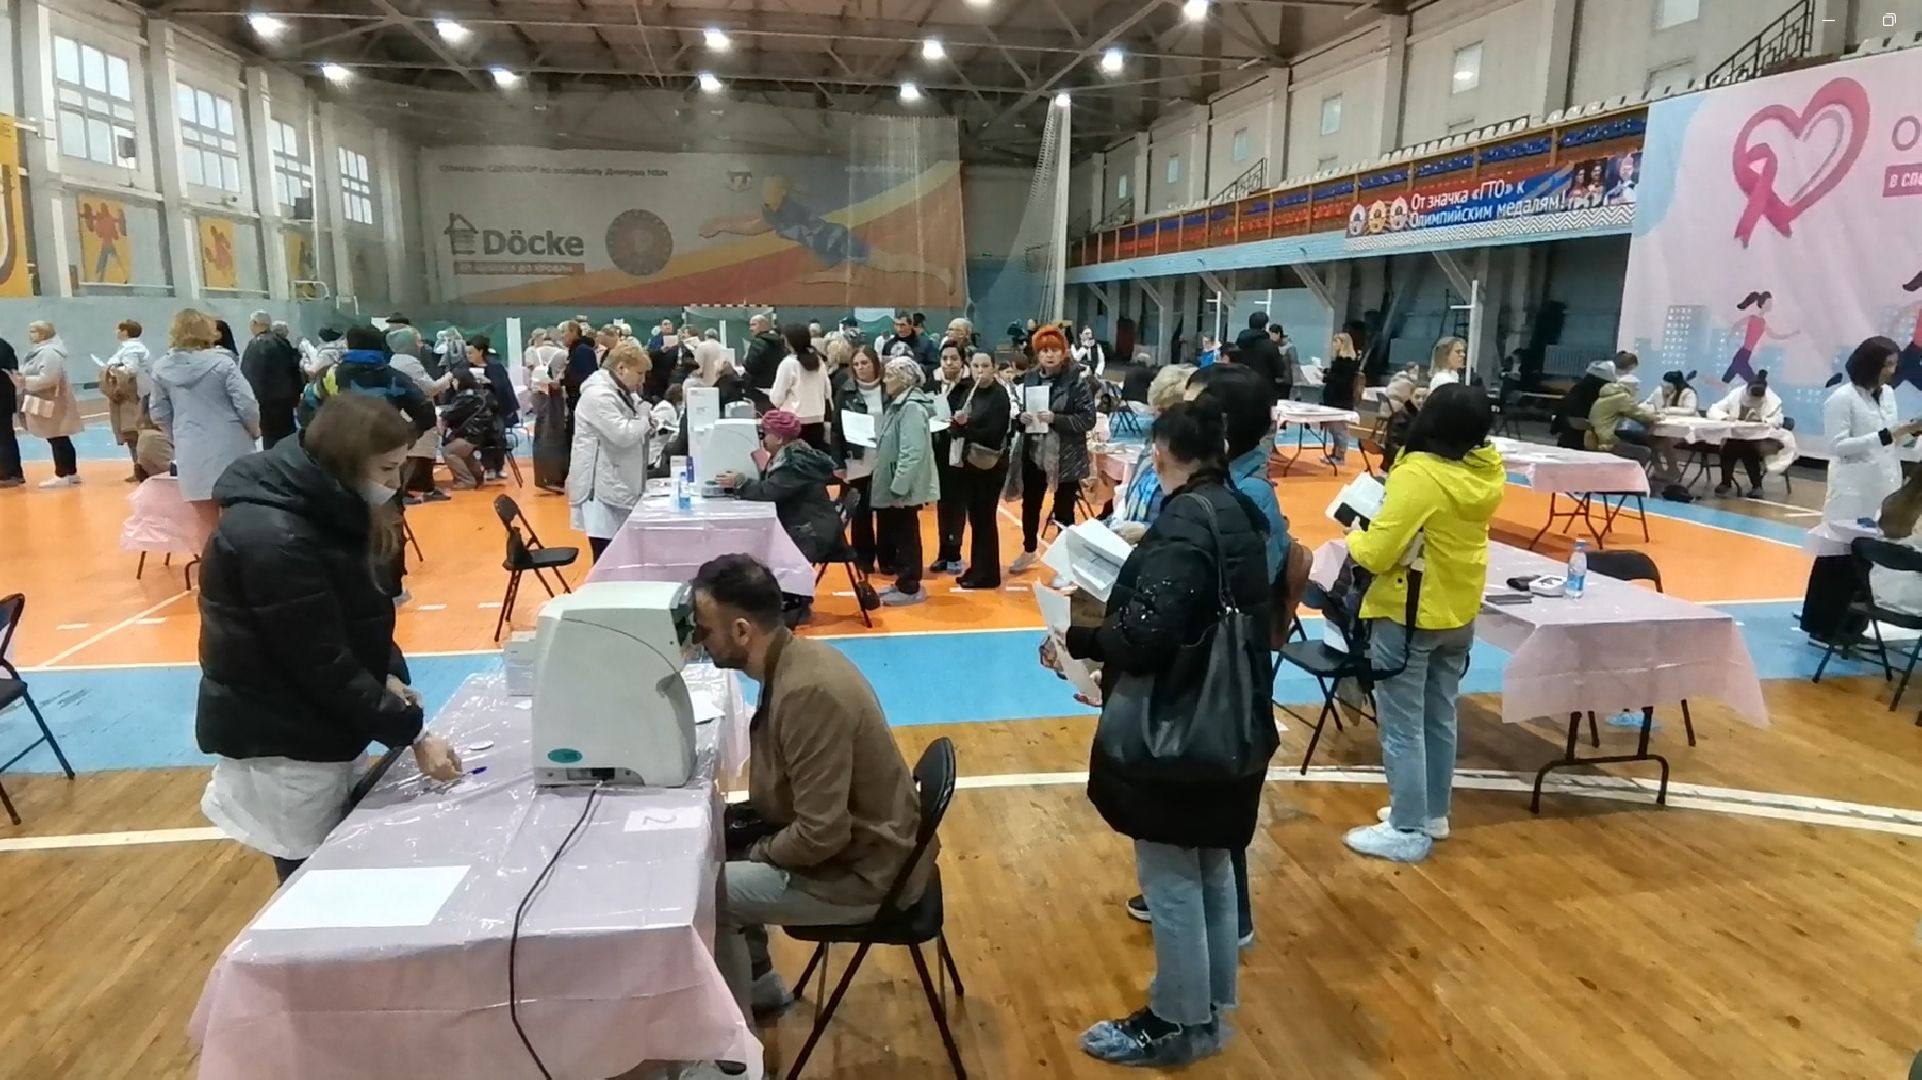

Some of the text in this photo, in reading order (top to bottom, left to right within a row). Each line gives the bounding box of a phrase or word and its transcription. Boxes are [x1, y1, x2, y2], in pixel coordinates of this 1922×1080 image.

[1411, 179, 1525, 210] От значка «ГТО» к
[1889, 173, 1899, 188] В
[1409, 189, 1565, 228] Олимпийским медалям!
[482, 229, 585, 257] Döcke
